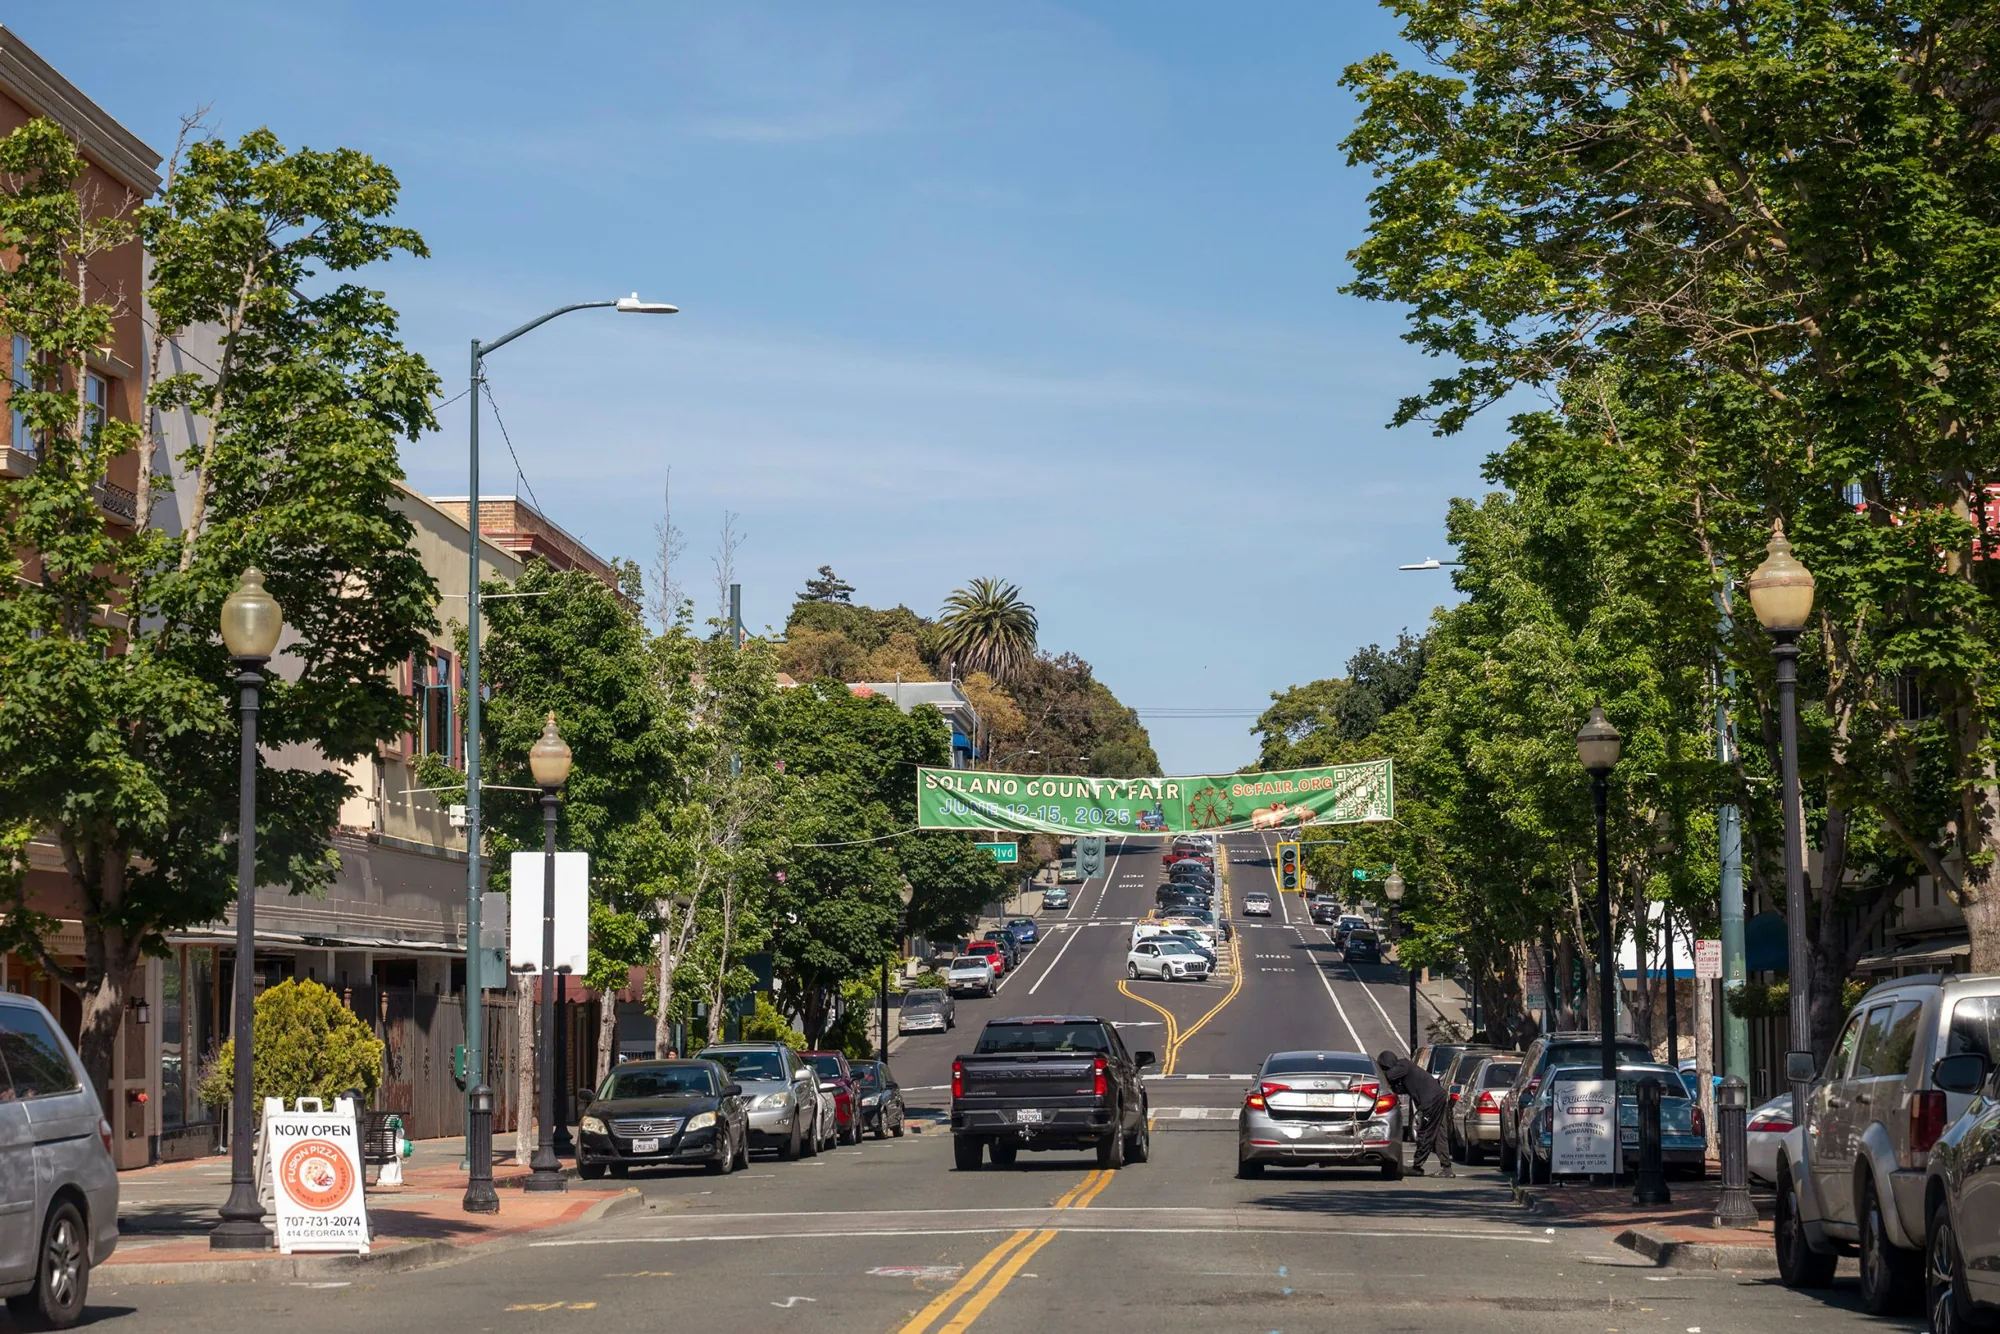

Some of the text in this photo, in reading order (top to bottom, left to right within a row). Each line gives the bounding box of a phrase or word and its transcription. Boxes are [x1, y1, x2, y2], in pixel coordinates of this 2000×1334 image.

[925, 774, 1179, 800] SOLANO COUNTY FAIR
[1232, 776, 1333, 797] SCFAIR.ORG
[939, 798, 999, 819] JUNE
[1075, 807, 1130, 825] 2025
[970, 1069, 1087, 1078] CHEVROLET
[275, 1125, 351, 1137] NOW OPEN
[288, 1146, 338, 1183] FUSION PIZZA
[284, 1216, 361, 1227] 707-731-2074
